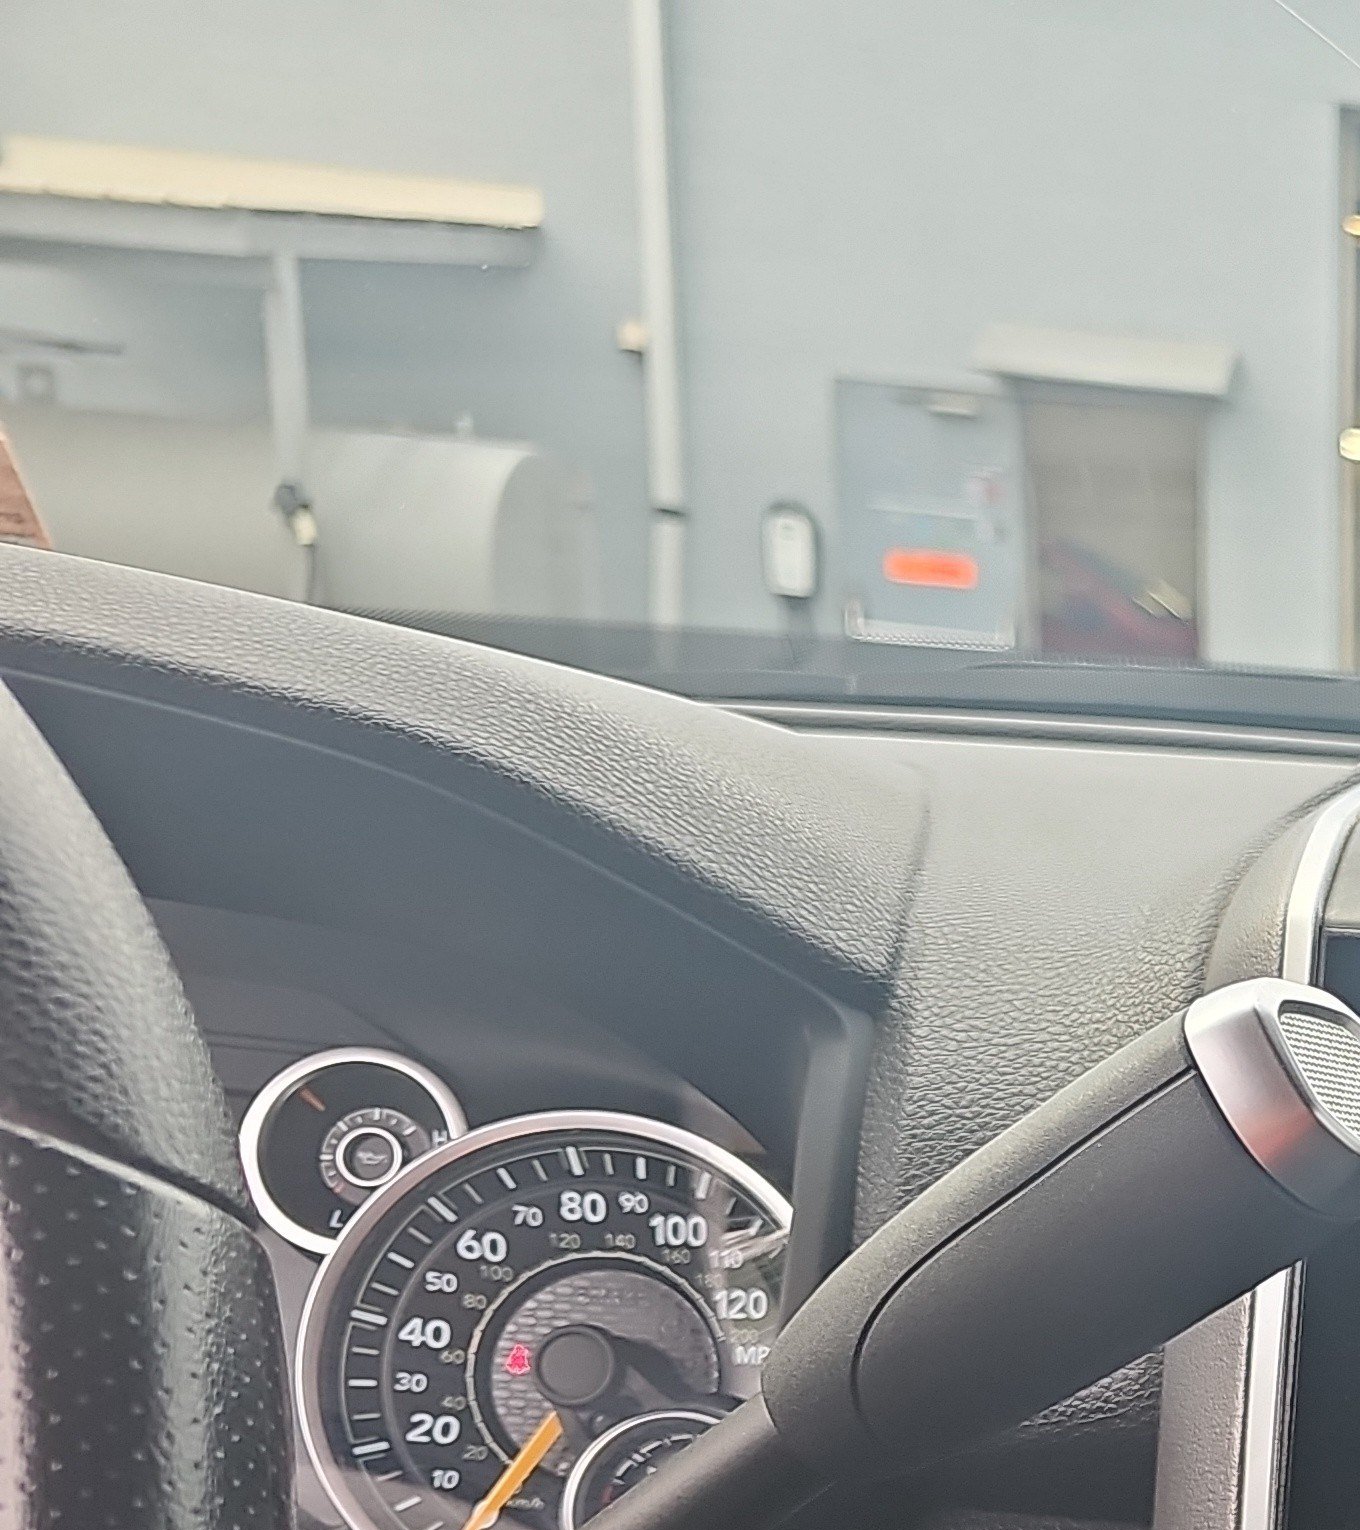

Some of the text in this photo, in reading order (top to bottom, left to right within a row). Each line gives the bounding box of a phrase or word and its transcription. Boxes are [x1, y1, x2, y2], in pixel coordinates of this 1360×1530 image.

[560, 1190, 607, 1222] 80
[617, 1191, 649, 1214] 90
[511, 1205, 544, 1228] 70
[550, 1232, 581, 1249] 120
[604, 1233, 637, 1249] 140
[649, 1214, 708, 1247] 100
[457, 1229, 507, 1262] 60
[425, 1270, 458, 1293] 50
[461, 1293, 487, 1310] 80
[714, 1287, 769, 1321] 120
[398, 1316, 451, 1348] 40
[438, 1348, 466, 1365] 60
[733, 1345, 771, 1366] MP
[393, 1371, 428, 1393] 30
[441, 1395, 467, 1412] 40
[405, 1412, 461, 1445] 20
[461, 1445, 489, 1461] 20
[430, 1469, 460, 1490] 10
